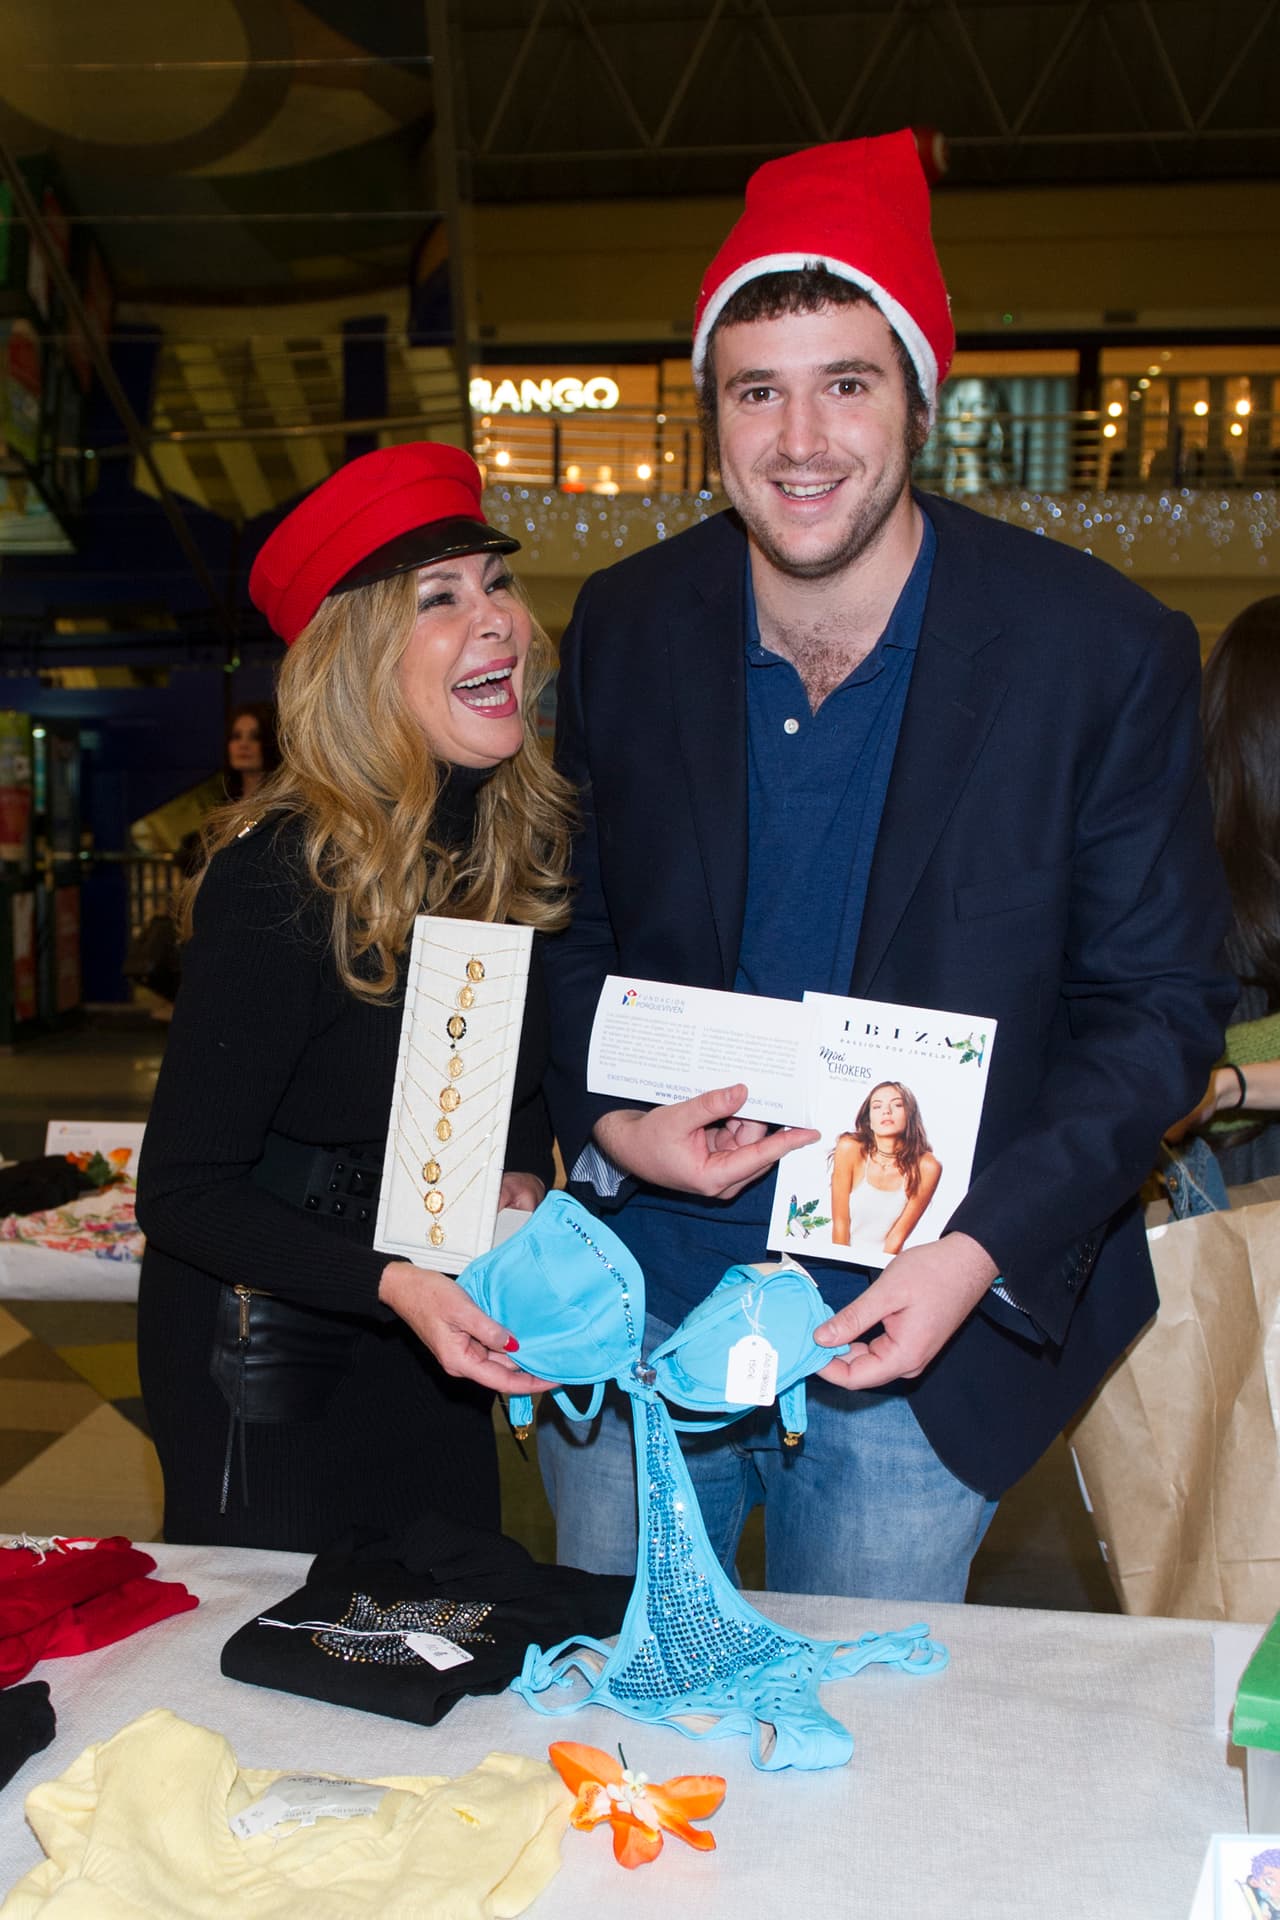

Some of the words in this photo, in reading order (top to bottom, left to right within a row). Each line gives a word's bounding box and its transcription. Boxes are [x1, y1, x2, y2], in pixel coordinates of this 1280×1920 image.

[844, 1020, 954, 1048] IBIZA
[817, 1045, 847, 1063] Mini
[840, 1038, 881, 1049] PASSION
[886, 1045, 903, 1053] FOR
[908, 1049, 952, 1061] JEWELRY
[828, 1061, 872, 1079] CHOKERS
